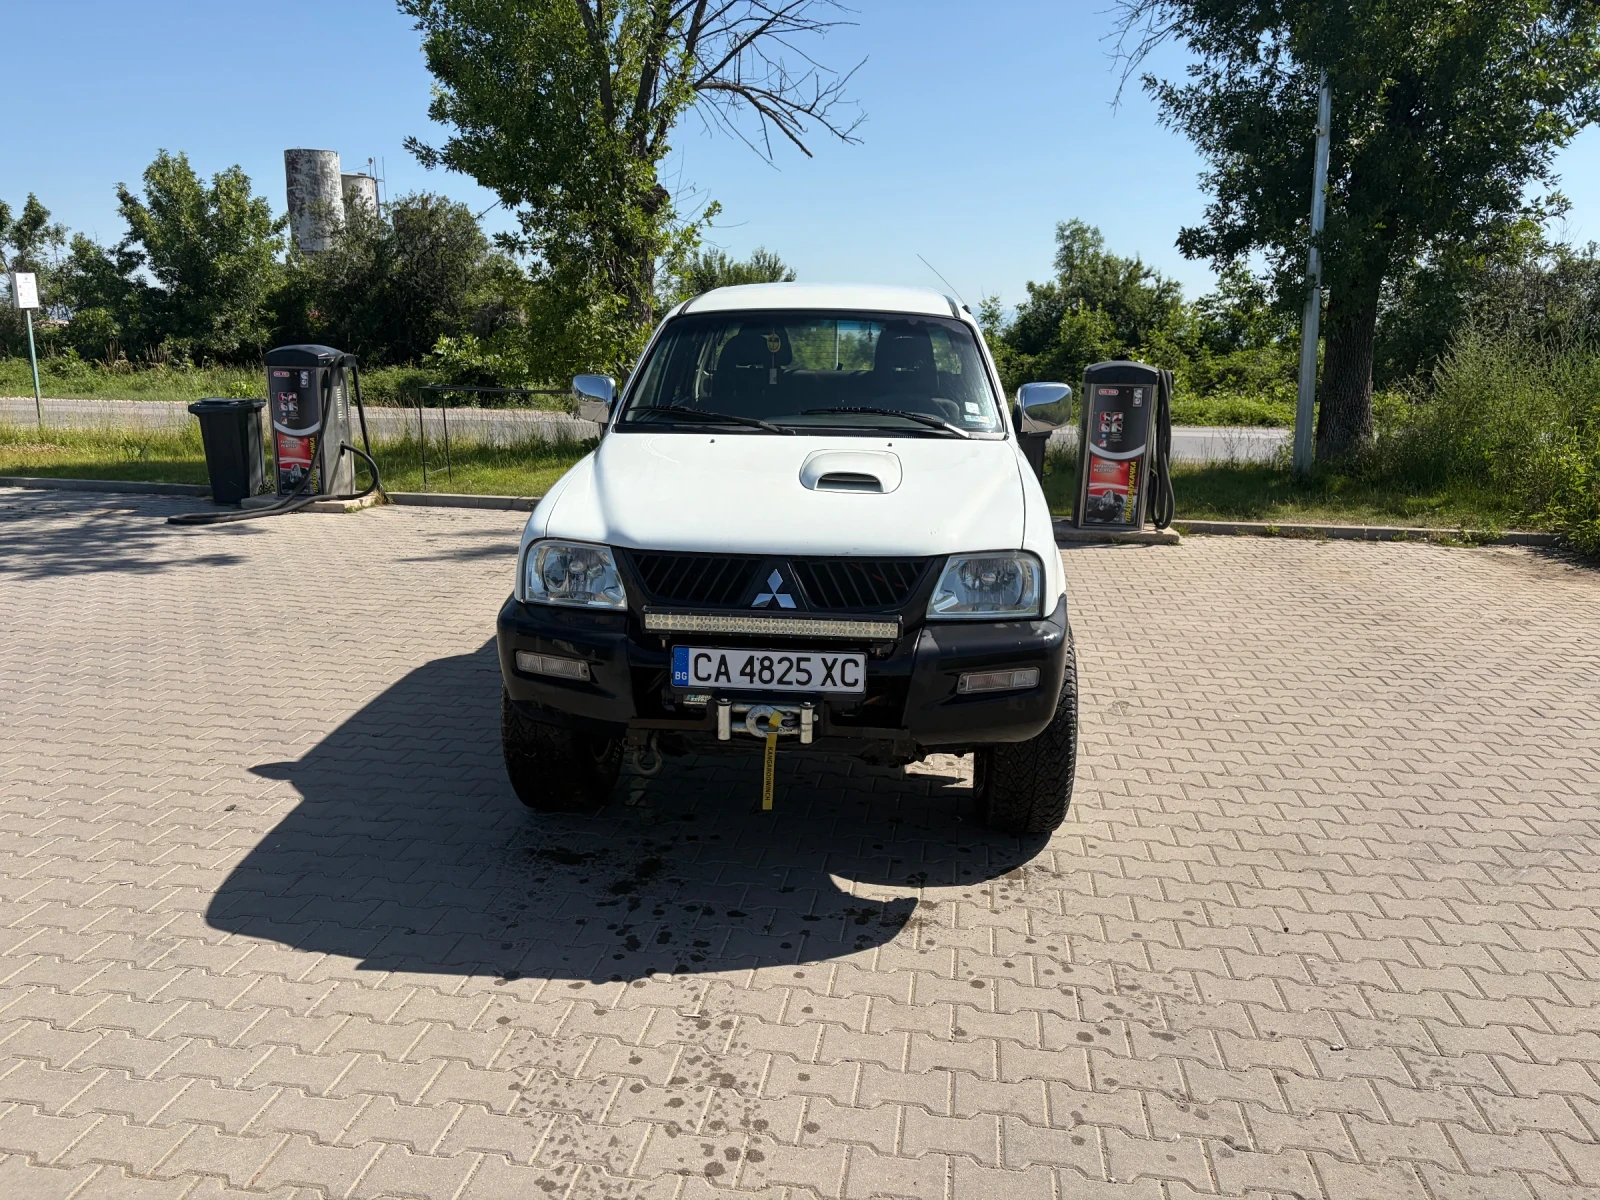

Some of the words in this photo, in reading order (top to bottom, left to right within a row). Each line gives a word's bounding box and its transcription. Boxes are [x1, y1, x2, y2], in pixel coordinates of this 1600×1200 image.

[675, 671, 688, 681] BG
[694, 653, 732, 683] CA
[739, 655, 813, 686] 4825
[820, 657, 860, 688] XC
[764, 746, 774, 801] KANGAROOWINCH
